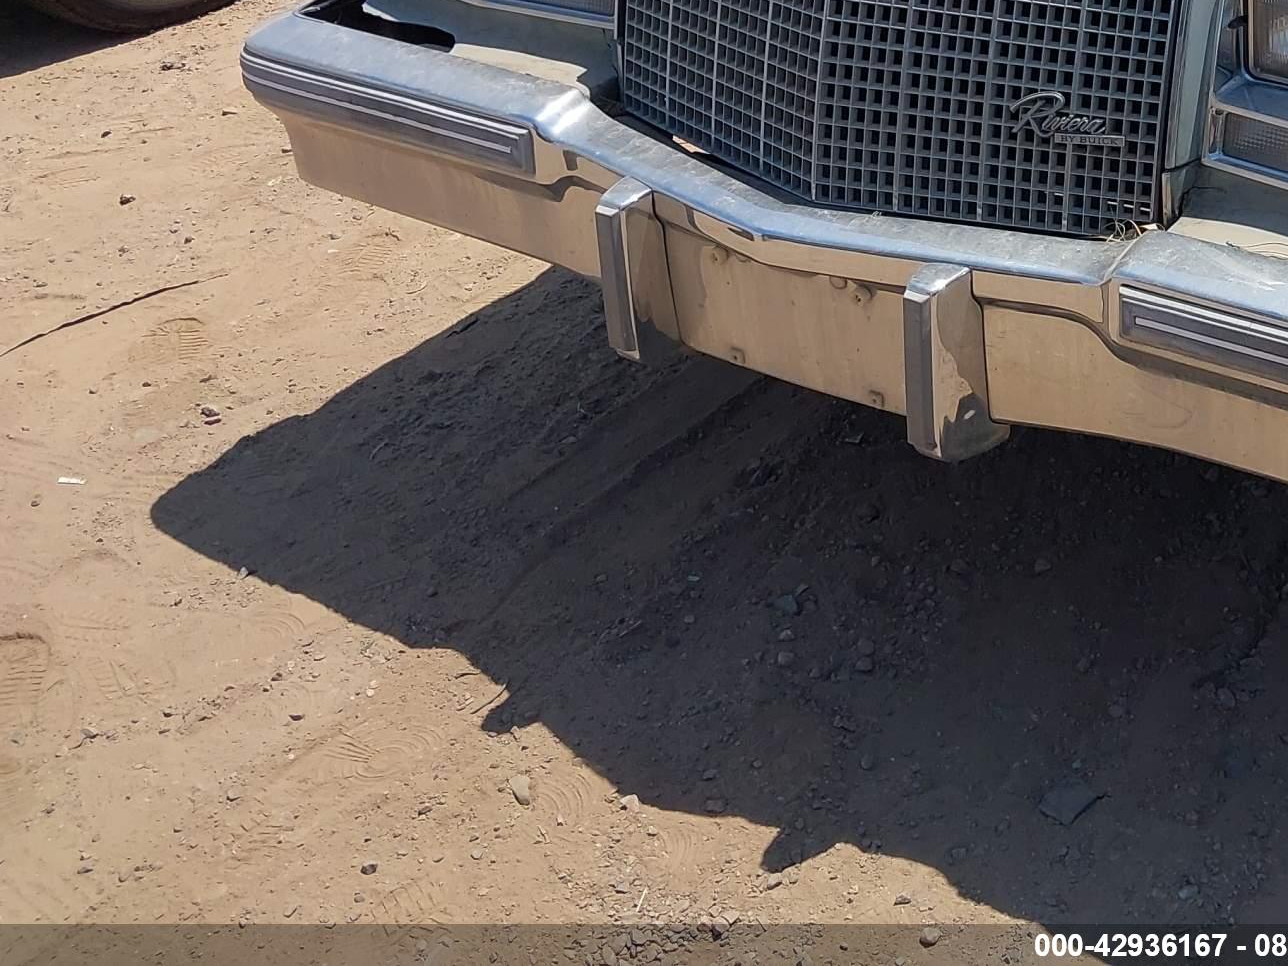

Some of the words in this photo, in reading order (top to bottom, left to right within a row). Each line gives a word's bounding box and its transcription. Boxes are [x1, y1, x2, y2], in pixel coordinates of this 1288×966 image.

[1009, 91, 1106, 138] Riviera
[1060, 135, 1073, 143] BY
[1080, 136, 1119, 145] BUICK
